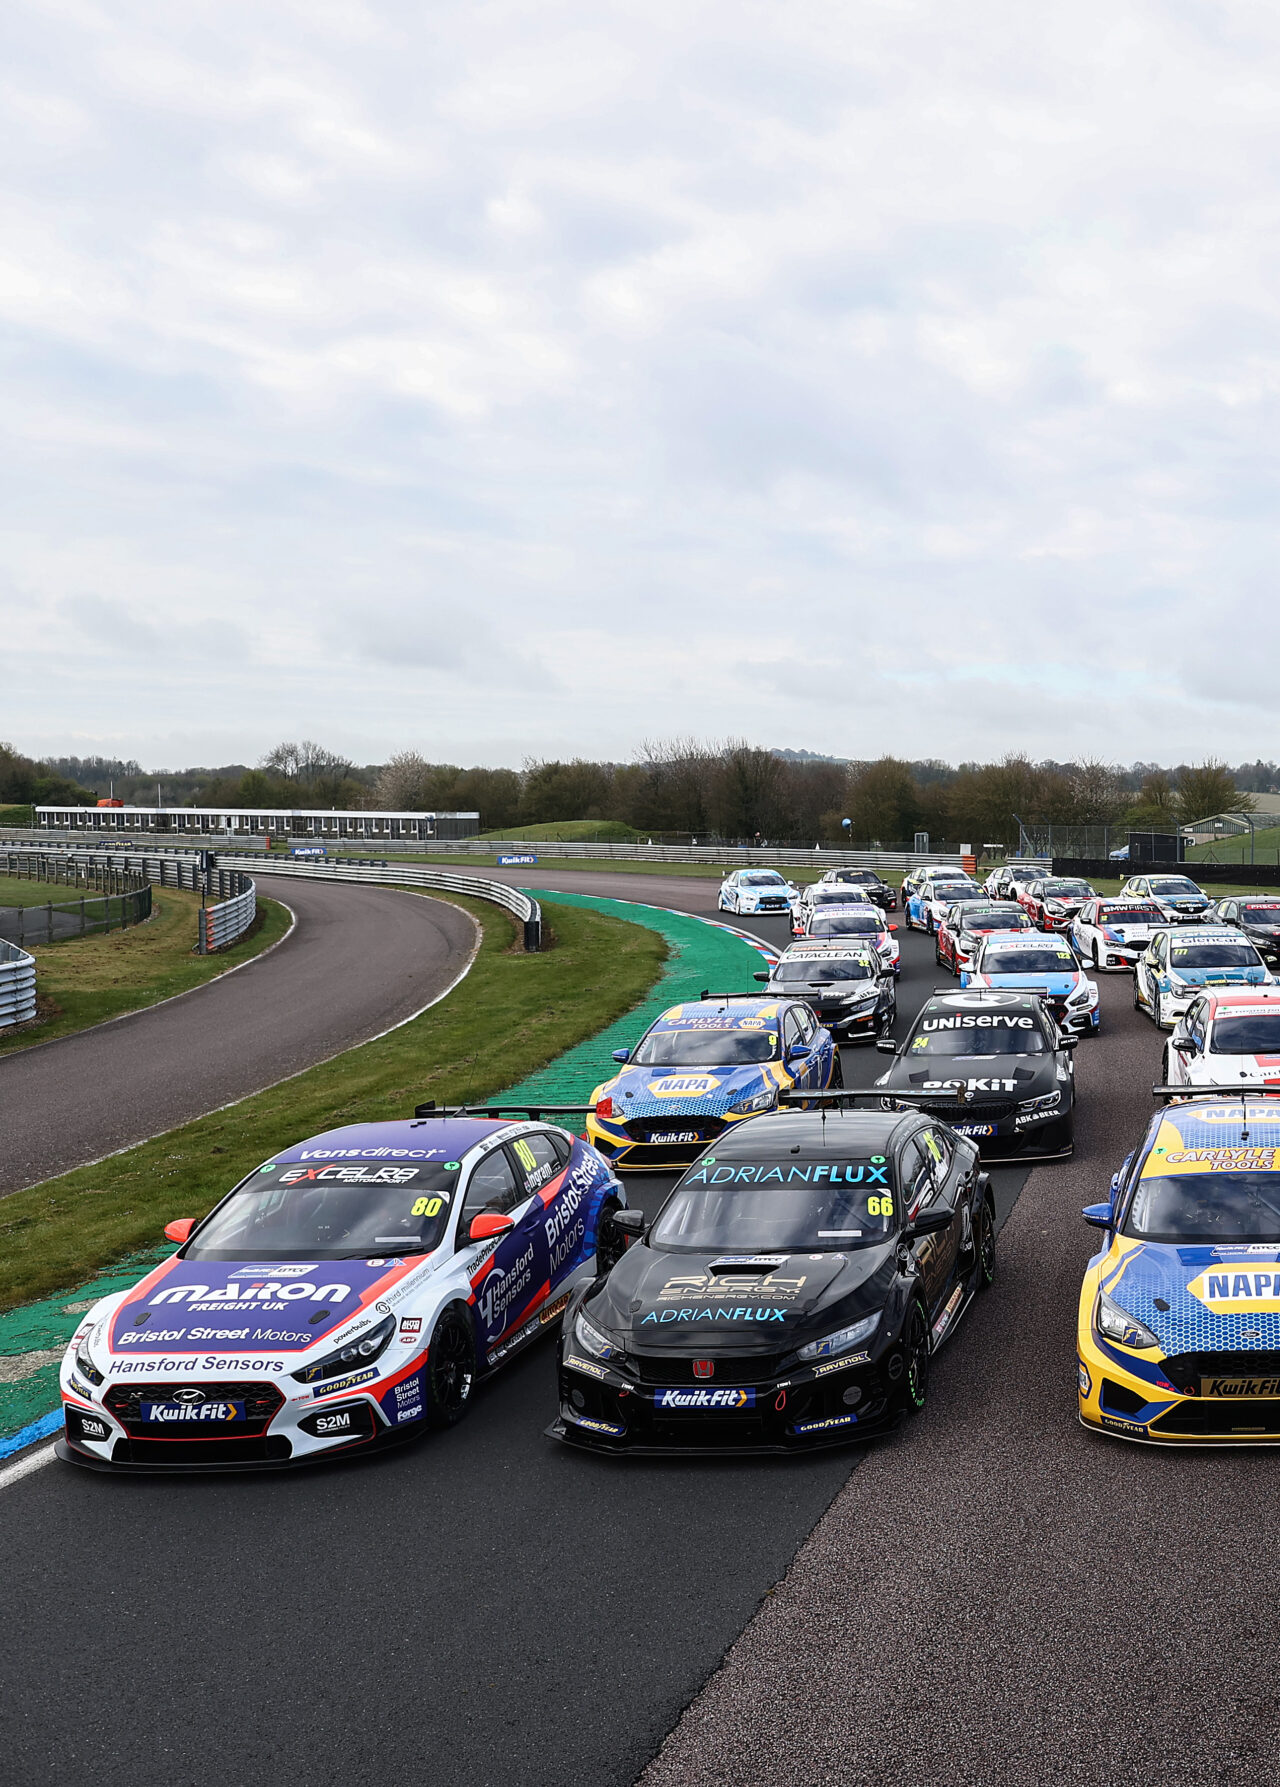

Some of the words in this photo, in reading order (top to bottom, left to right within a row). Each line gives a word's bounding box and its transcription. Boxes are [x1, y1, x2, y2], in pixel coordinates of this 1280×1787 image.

[786, 951, 862, 960] CATACLEAN
[667, 1017, 735, 1026] CARLYLE
[742, 1019, 762, 1027] NAPA
[768, 1035, 777, 1045] 9
[911, 1037, 929, 1048] 24
[658, 1077, 710, 1092] NAPA
[1015, 1115, 1033, 1125] ABK
[1039, 1109, 1061, 1119] BEER
[513, 1139, 538, 1172] 80
[1165, 1149, 1276, 1163] CARLYLE
[1211, 1160, 1274, 1170] TOOLS
[279, 1164, 420, 1185] EXCELR8
[528, 1161, 553, 1188] Ingram
[411, 1197, 443, 1217] 80
[544, 1179, 582, 1249] Bristol
[572, 1148, 600, 1190] Street
[867, 1196, 894, 1216] 66
[549, 1217, 586, 1277] Motors
[493, 1243, 534, 1299] Hansford
[665, 1275, 807, 1289] RICH
[386, 1290, 401, 1305] third
[493, 1267, 531, 1319] Sensors
[187, 1301, 260, 1312] FREIGHT
[262, 1301, 289, 1311] UK
[117, 1328, 185, 1345] Bristol
[186, 1327, 251, 1340] Street
[252, 1329, 312, 1343] Motors
[333, 1319, 372, 1345] powerbulbs
[108, 1357, 199, 1375] Hansford
[202, 1356, 284, 1372] Sensors
[569, 1358, 603, 1378] RAVENOL
[819, 1355, 866, 1374] RAVENOL
[319, 1371, 374, 1394] GOODYEAR
[394, 1377, 420, 1395] Bristol
[396, 1386, 420, 1401] Street
[397, 1395, 421, 1409] Motors
[316, 1412, 350, 1430] S2M
[397, 1404, 423, 1422] Forge
[82, 1419, 105, 1435] S2M
[581, 1419, 619, 1433] GOODYEAR
[800, 1415, 851, 1431] GOODYEAR
[1104, 1418, 1144, 1433] GOODYEAR
